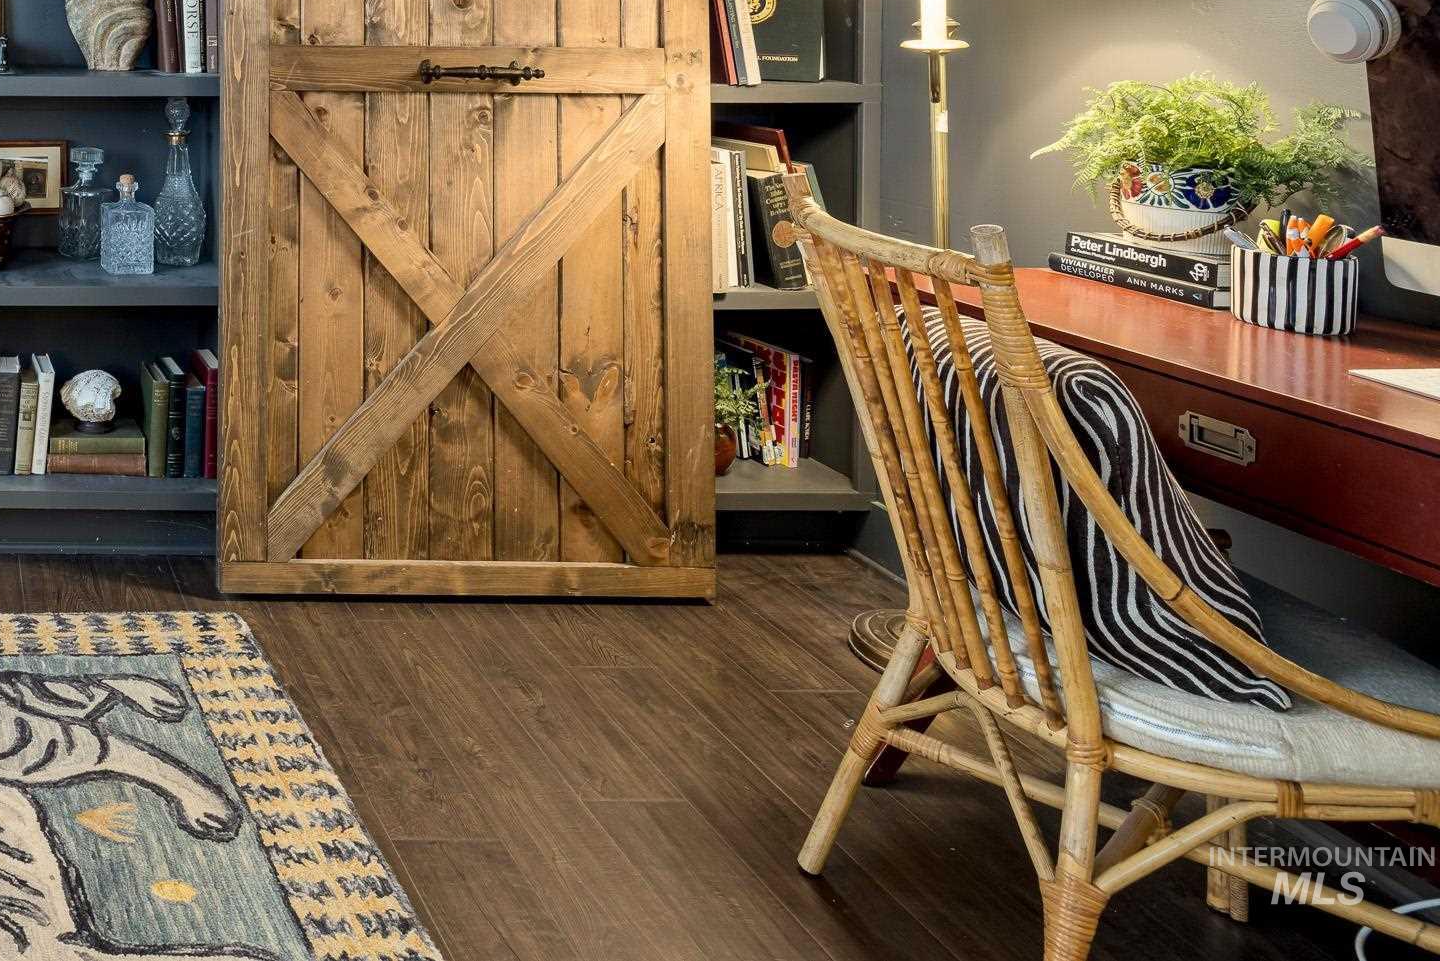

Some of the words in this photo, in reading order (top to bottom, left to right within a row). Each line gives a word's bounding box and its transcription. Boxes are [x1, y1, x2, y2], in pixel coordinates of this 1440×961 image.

[714, 168, 724, 211] AFRICA
[1060, 257, 1088, 269] VIVIAN
[1088, 263, 1115, 276] MAIER
[1071, 235, 1103, 253] Peter
[1104, 244, 1167, 268] Lindbergh
[1060, 264, 1115, 283] DEVELOPED
[1126, 276, 1147, 287] ANN
[1150, 282, 1185, 297] MARKS
[792, 360, 800, 391] PASTA
[791, 392, 799, 423] NIGHT
